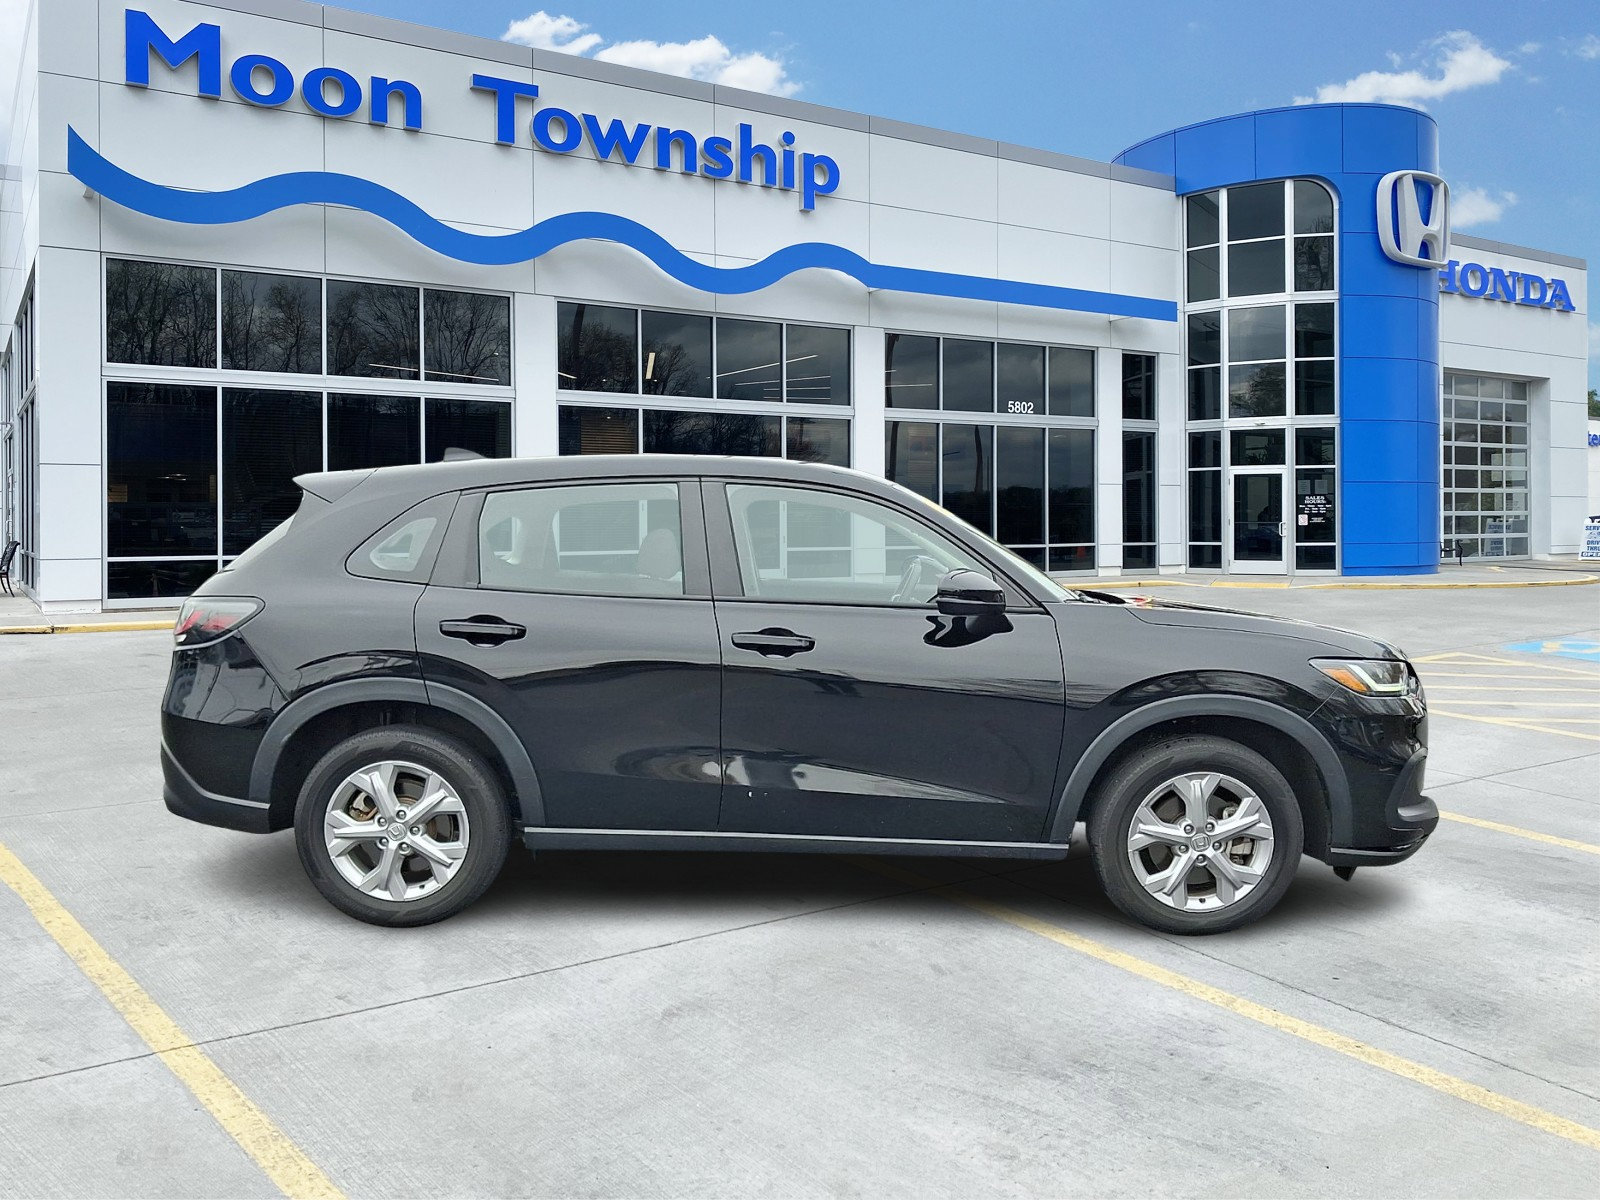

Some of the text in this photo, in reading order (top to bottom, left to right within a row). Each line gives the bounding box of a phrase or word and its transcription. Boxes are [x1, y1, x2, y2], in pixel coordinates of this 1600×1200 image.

[125, 9, 840, 212] Moon Township
[1007, 400, 1034, 414] 5802
